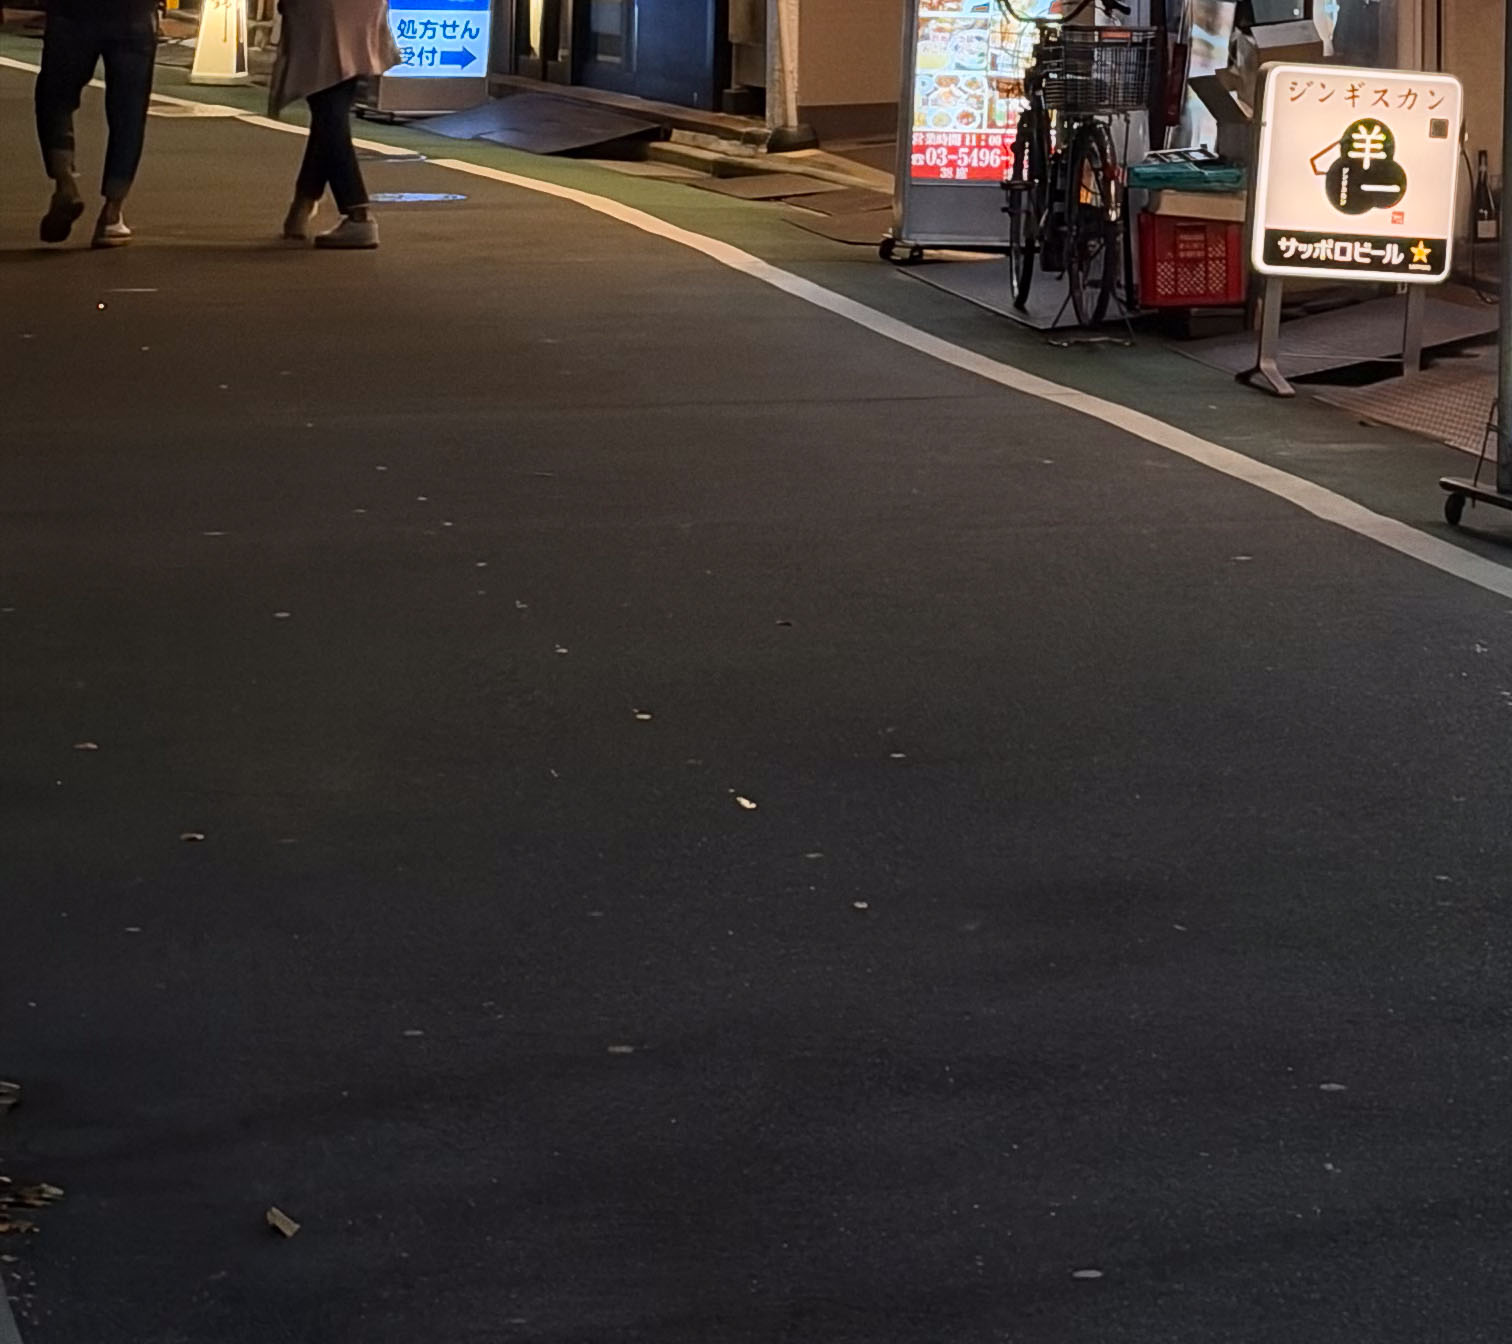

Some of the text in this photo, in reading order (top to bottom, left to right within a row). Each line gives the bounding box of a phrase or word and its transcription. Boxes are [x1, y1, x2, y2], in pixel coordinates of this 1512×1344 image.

[397, 18, 480, 40] 処方せん
[400, 47, 438, 68] 受付
[1289, 80, 1446, 111] ジンギスカン
[1348, 124, 1401, 193] 羊一
[1277, 236, 1405, 265] サッポロビール
